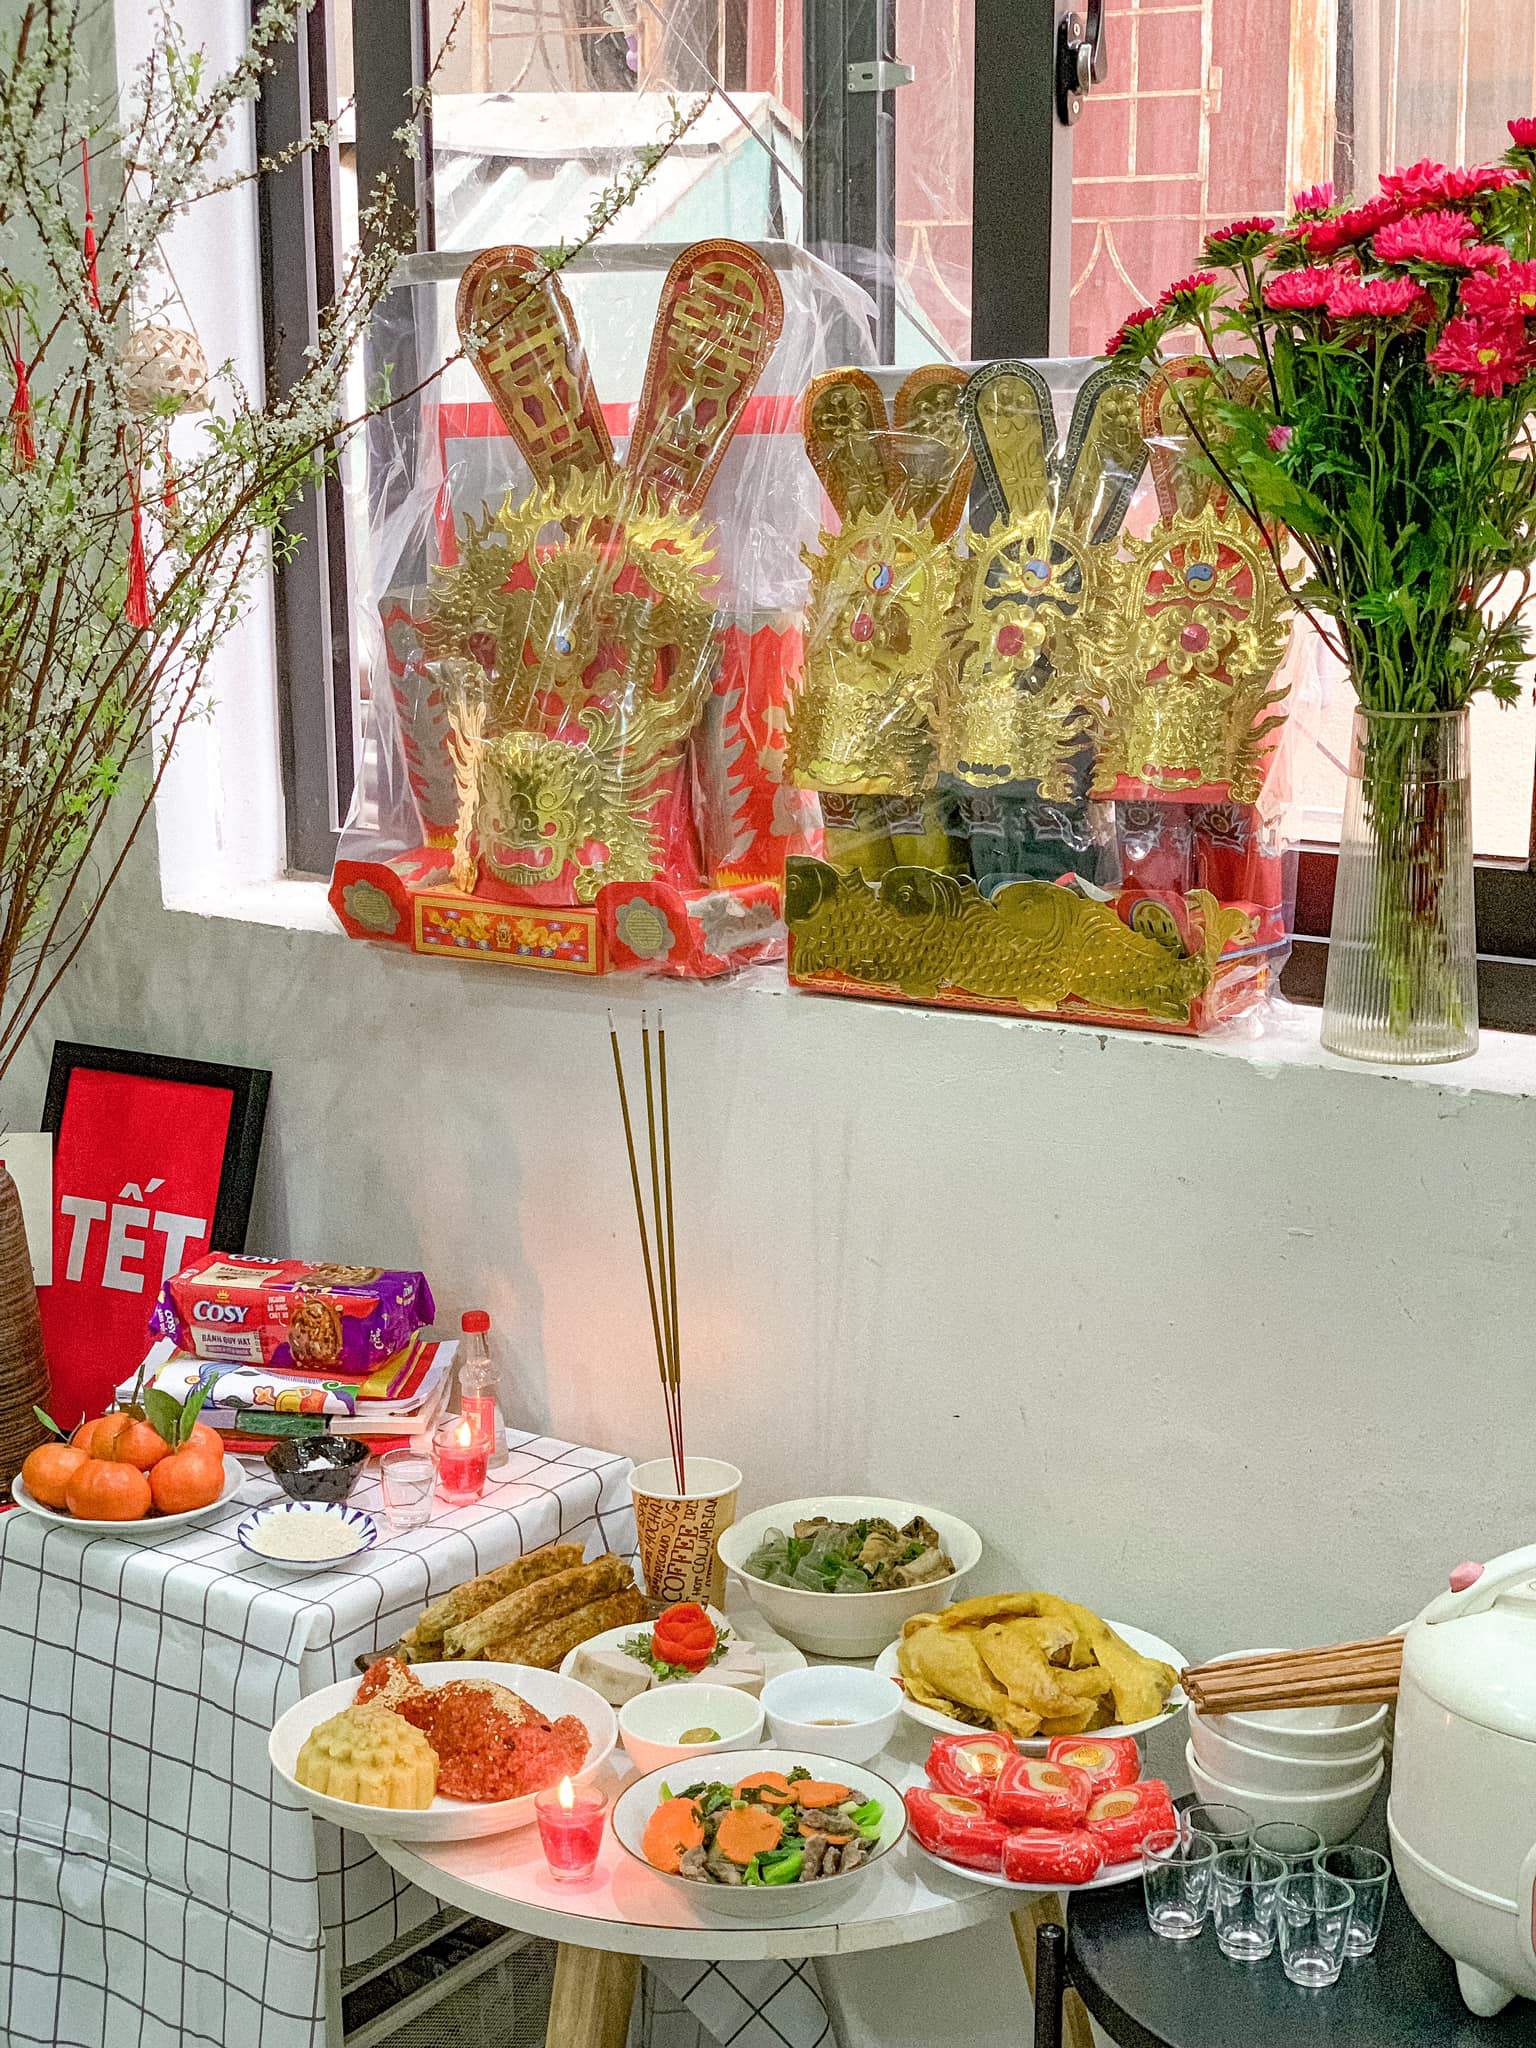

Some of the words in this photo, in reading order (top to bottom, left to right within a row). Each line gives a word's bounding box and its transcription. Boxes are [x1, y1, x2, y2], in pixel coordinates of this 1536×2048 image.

[61, 1177, 207, 1294] TẾT
[228, 1253, 283, 1265] COSY
[193, 1300, 249, 1323] COSY
[645, 1502, 664, 1550] MOCHA
[661, 1524, 699, 1603] COFFEE
[691, 1576, 704, 1596] HOT
